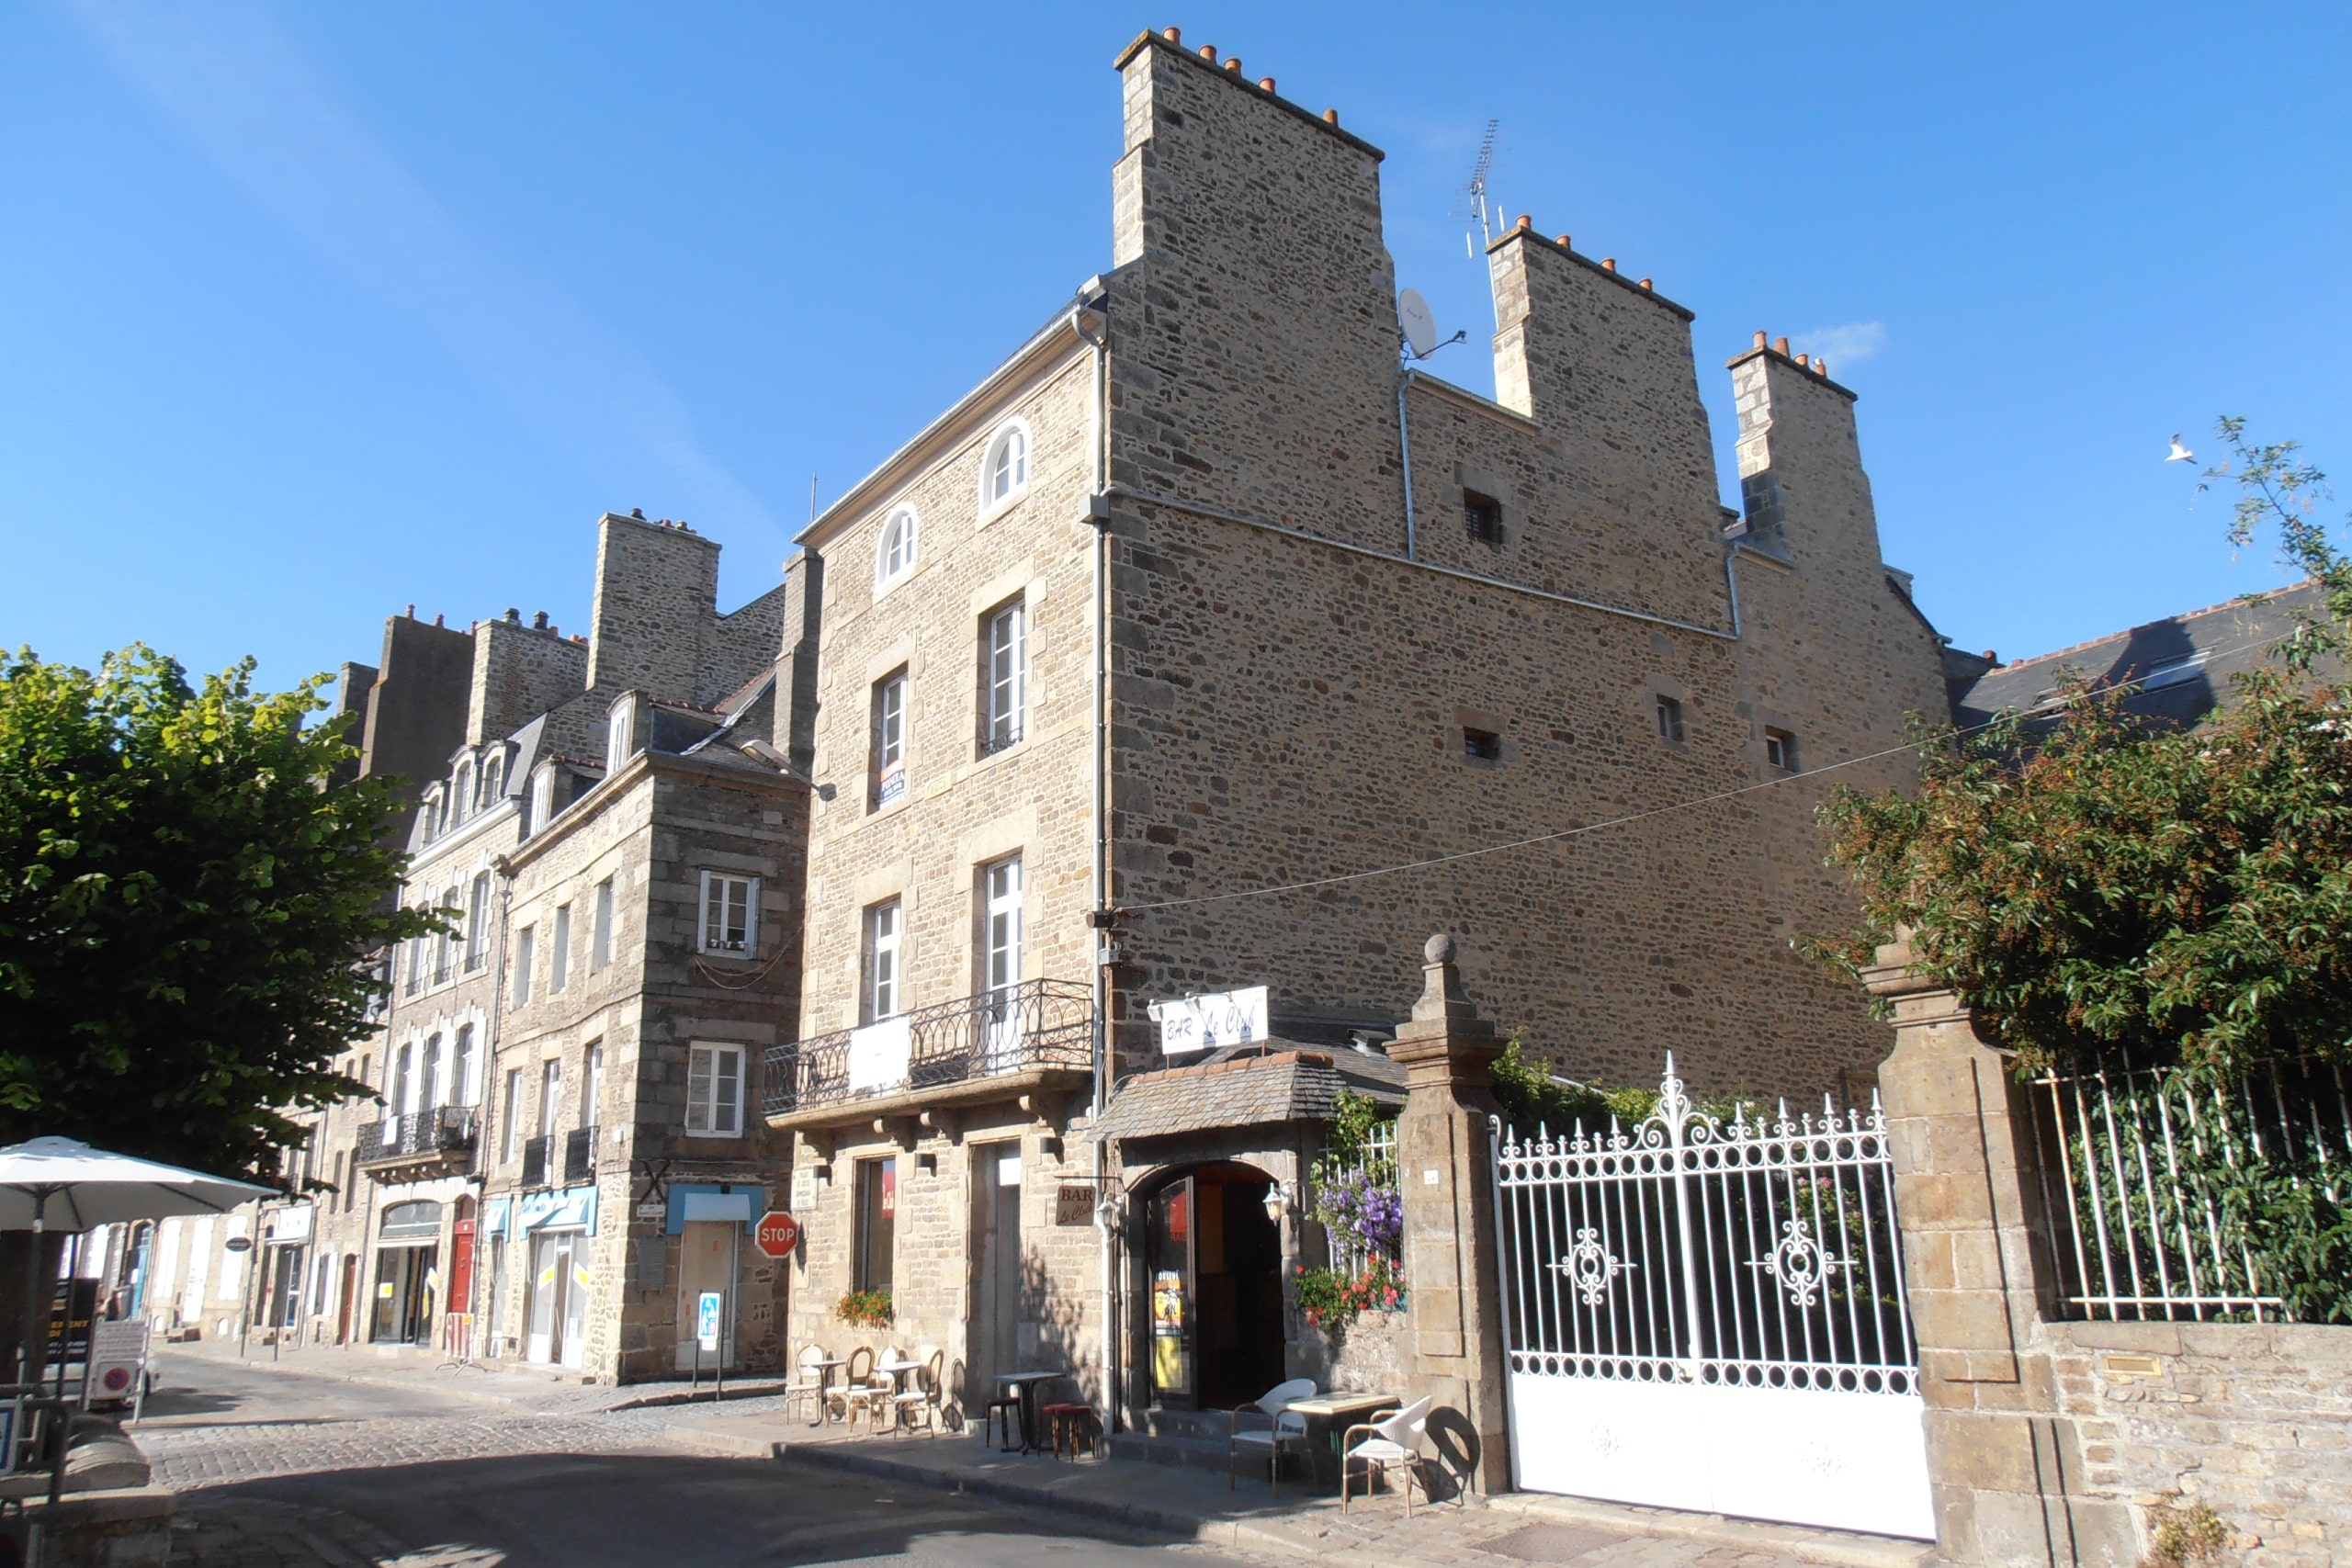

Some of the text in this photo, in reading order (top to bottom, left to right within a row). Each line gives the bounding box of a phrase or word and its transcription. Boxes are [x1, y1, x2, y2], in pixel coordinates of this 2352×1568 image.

[1167, 1017, 1193, 1041] BAR
[1060, 1189, 1093, 1202] BAR
[1057, 1204, 1092, 1224] Le Club
[762, 1227, 795, 1242] STOP
